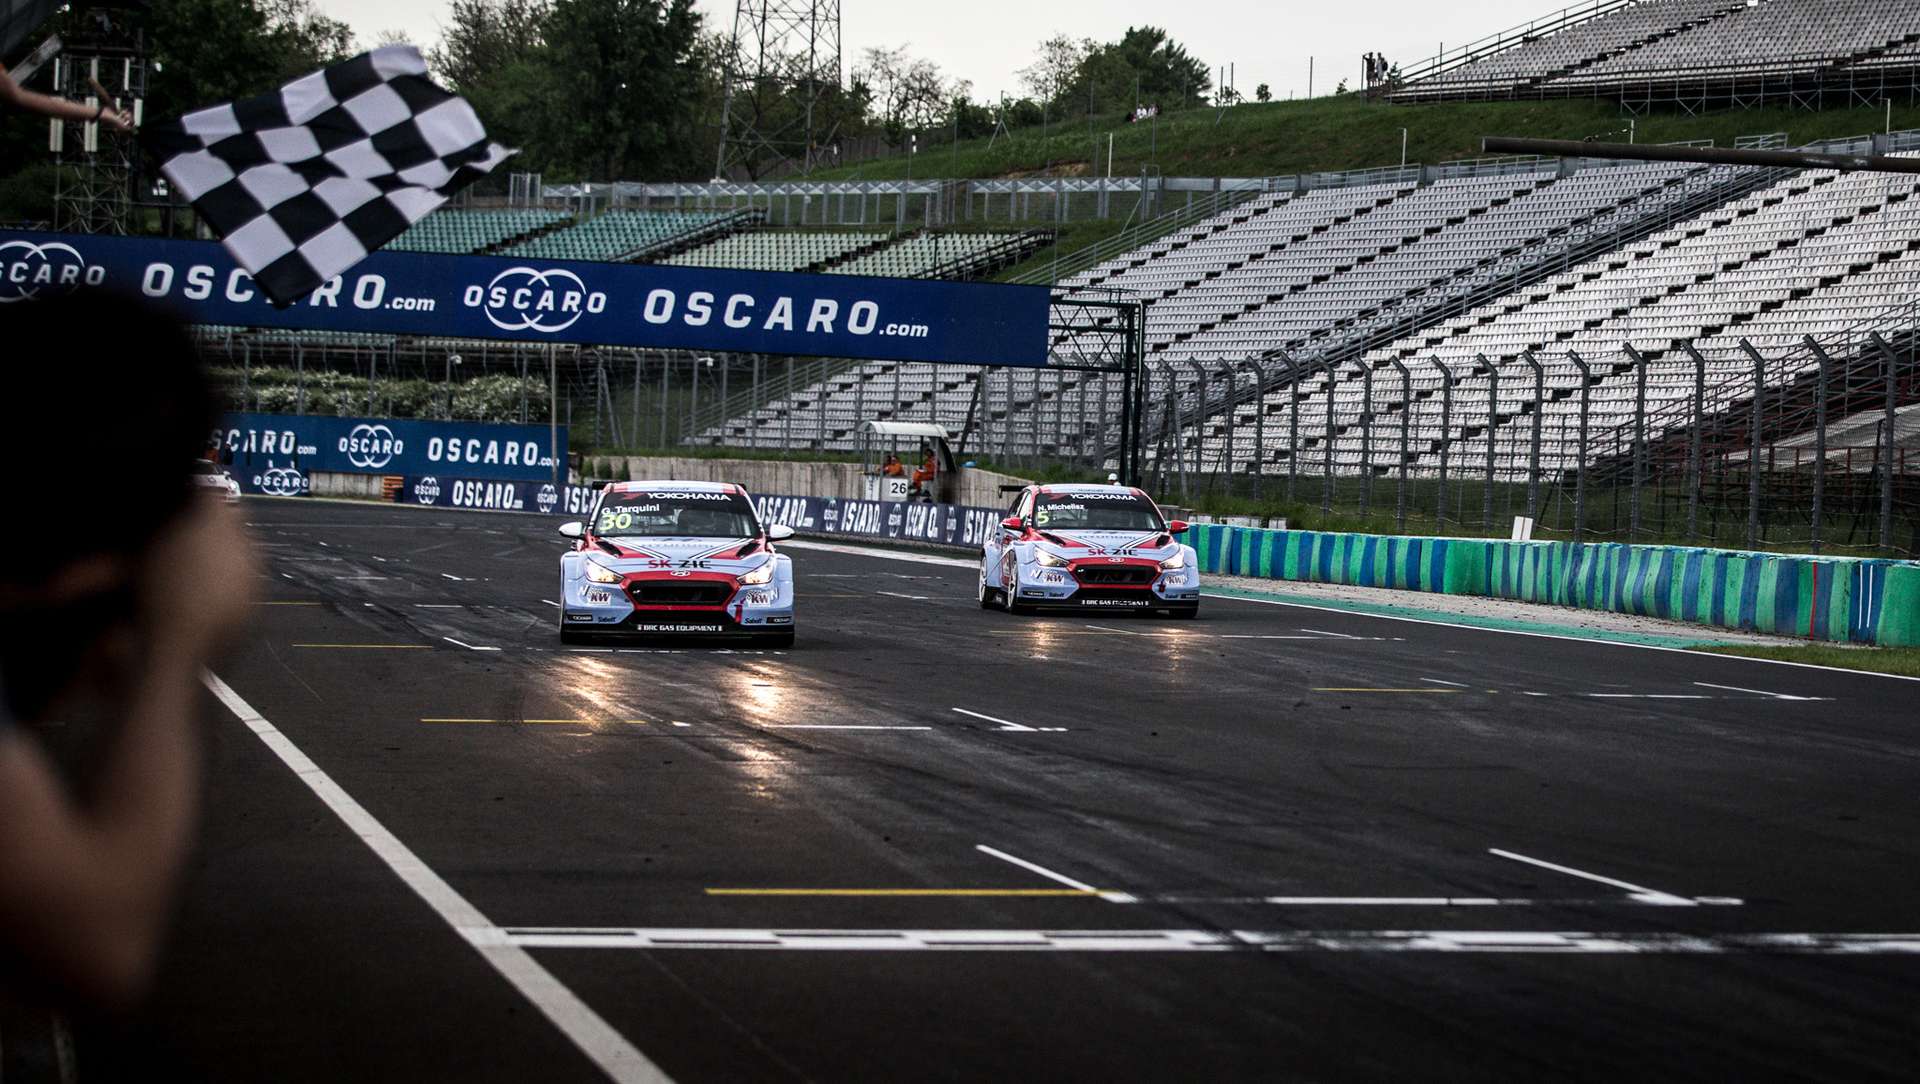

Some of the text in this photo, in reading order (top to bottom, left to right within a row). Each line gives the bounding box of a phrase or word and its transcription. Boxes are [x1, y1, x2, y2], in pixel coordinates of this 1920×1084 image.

[142, 262, 435, 312] OSCRO.com
[463, 285, 607, 313] OSCARO
[643, 288, 929, 338] OSCARO.com
[338, 437, 404, 456] OSCARO
[253, 475, 309, 489] OSCARO
[890, 482, 907, 494] 26
[648, 492, 732, 502] YOKOHAMA
[1070, 493, 1137, 501] YOKOHAMA
[615, 504, 660, 514] Tarquini
[600, 513, 632, 531] 30
[1037, 511, 1050, 524] 5
[648, 560, 711, 569] SK ZIC
[590, 592, 610, 602] KW
